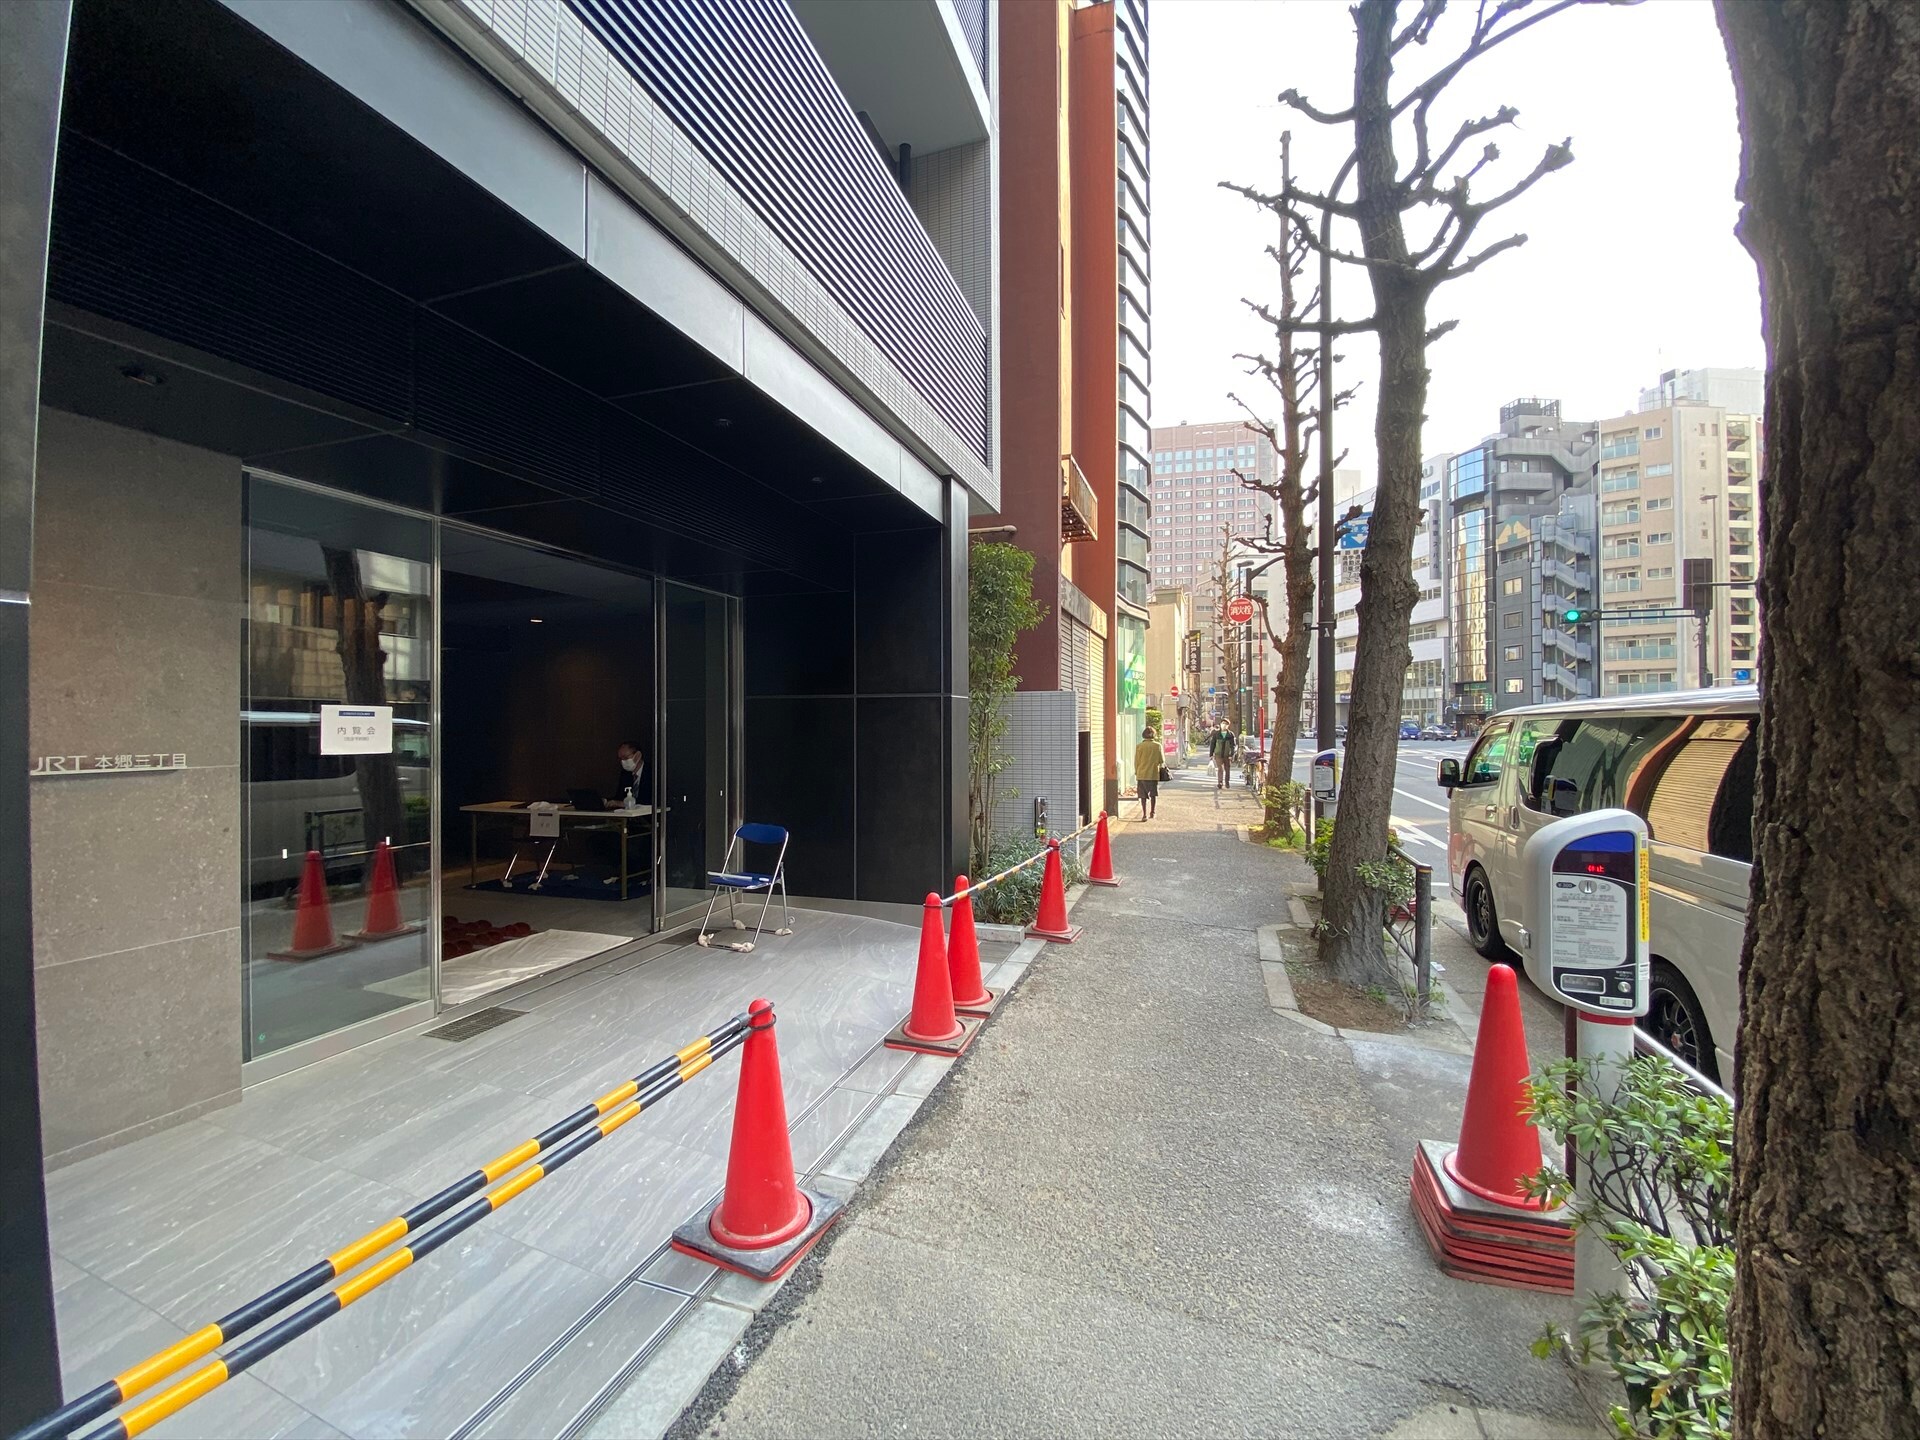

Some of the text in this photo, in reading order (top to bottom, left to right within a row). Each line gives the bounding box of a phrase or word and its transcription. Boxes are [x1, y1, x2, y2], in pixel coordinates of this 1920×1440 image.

[1230, 605, 1252, 616] 消火栓
[337, 726, 376, 736] 内覧会
[32, 753, 187, 772] JRT 本郷三丁目
